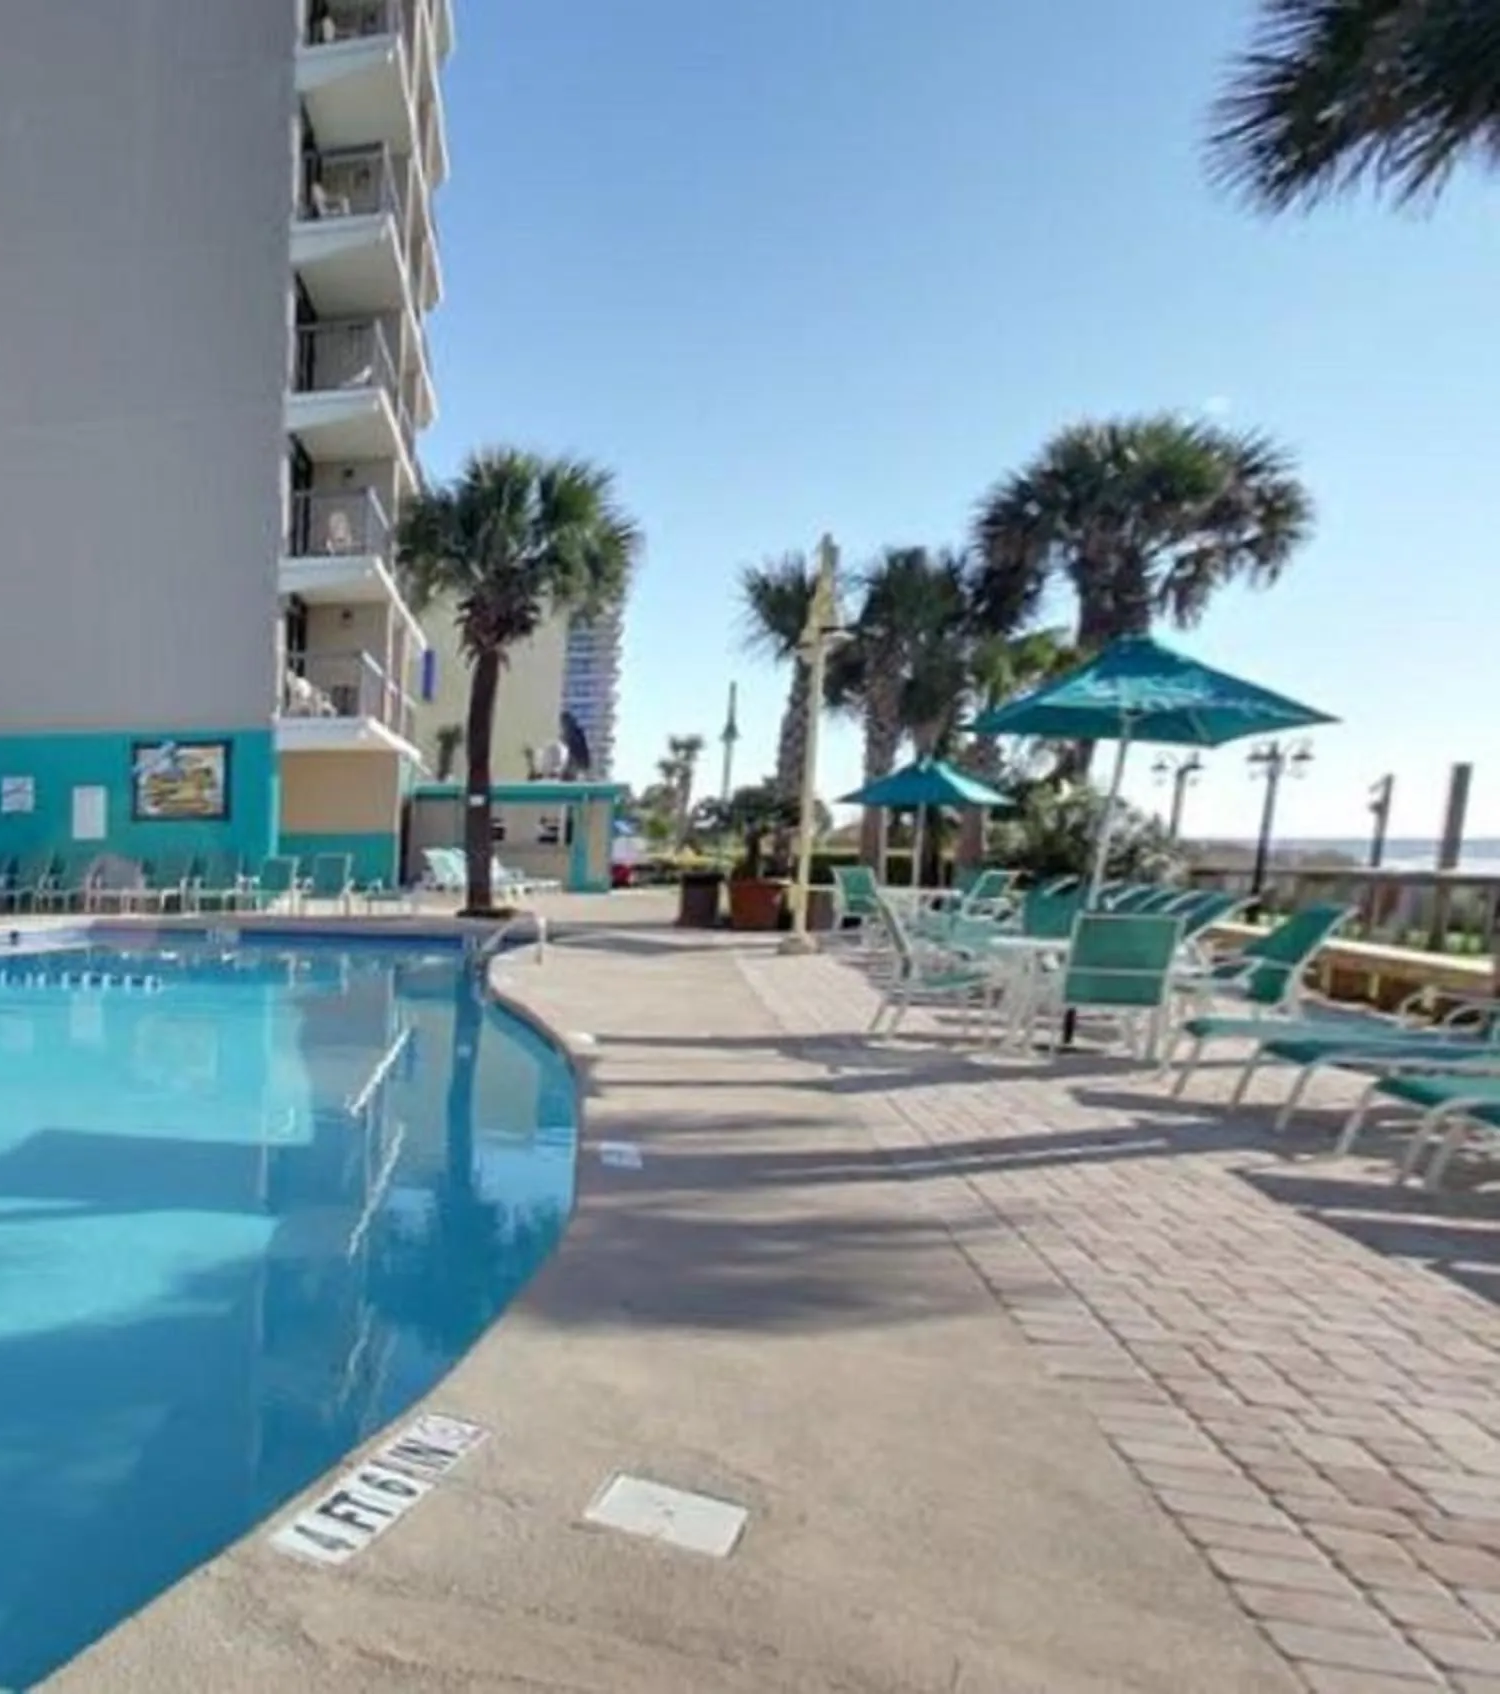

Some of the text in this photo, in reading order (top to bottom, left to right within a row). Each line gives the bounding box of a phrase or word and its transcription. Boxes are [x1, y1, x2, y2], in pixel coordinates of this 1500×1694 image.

[293, 1436, 460, 1552] 4 FT 6 IN
